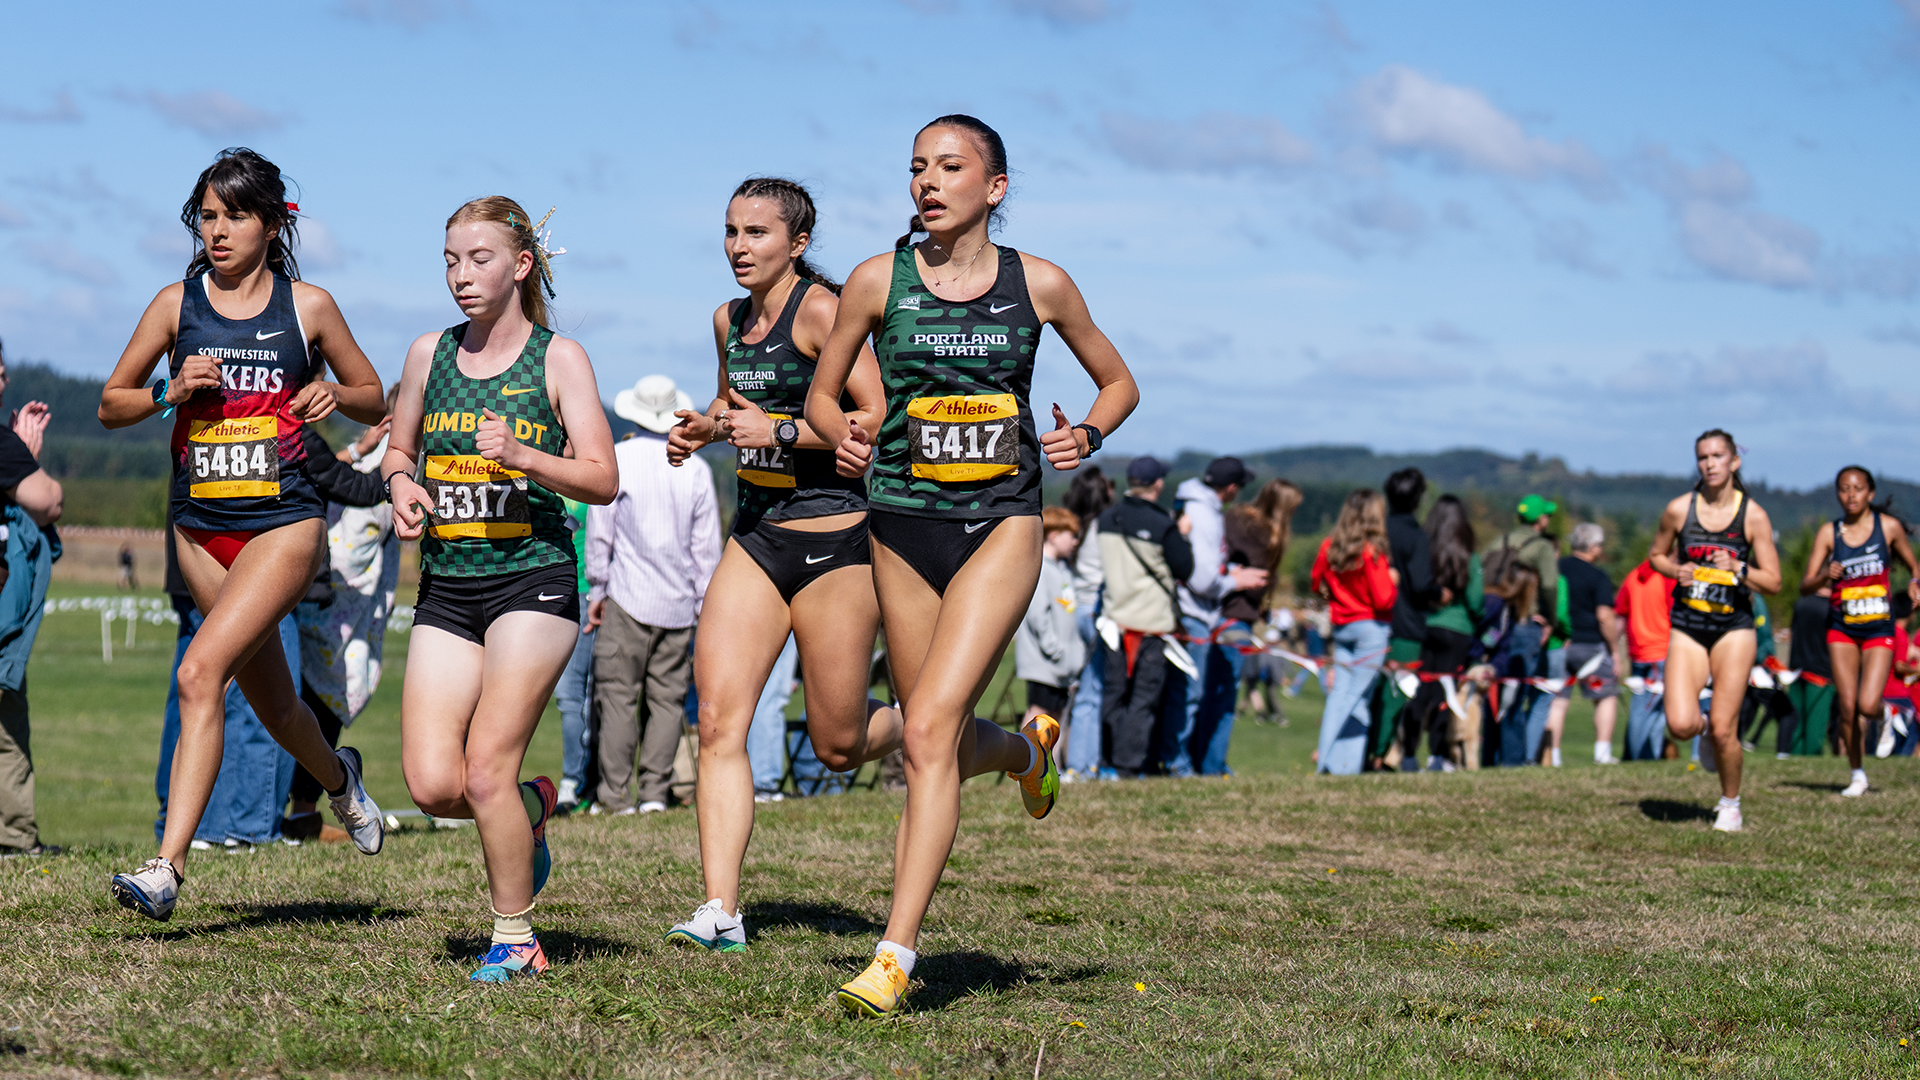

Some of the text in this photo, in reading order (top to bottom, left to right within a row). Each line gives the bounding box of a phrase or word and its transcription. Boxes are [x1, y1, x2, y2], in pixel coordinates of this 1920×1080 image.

[914, 333, 1007, 345] PORTLAND
[198, 347, 278, 361] SOUTHWESTERN
[934, 345, 989, 356] STATE
[221, 365, 284, 394] KERS
[729, 371, 776, 381] PORTLAND
[737, 380, 766, 390] STATE
[926, 399, 998, 415] Athletic
[198, 423, 260, 437] Athletic
[921, 424, 1004, 459] 5417
[194, 444, 268, 478] 5484
[741, 446, 784, 468] 5412
[442, 460, 506, 475] Athletic
[438, 485, 512, 519] 5317
